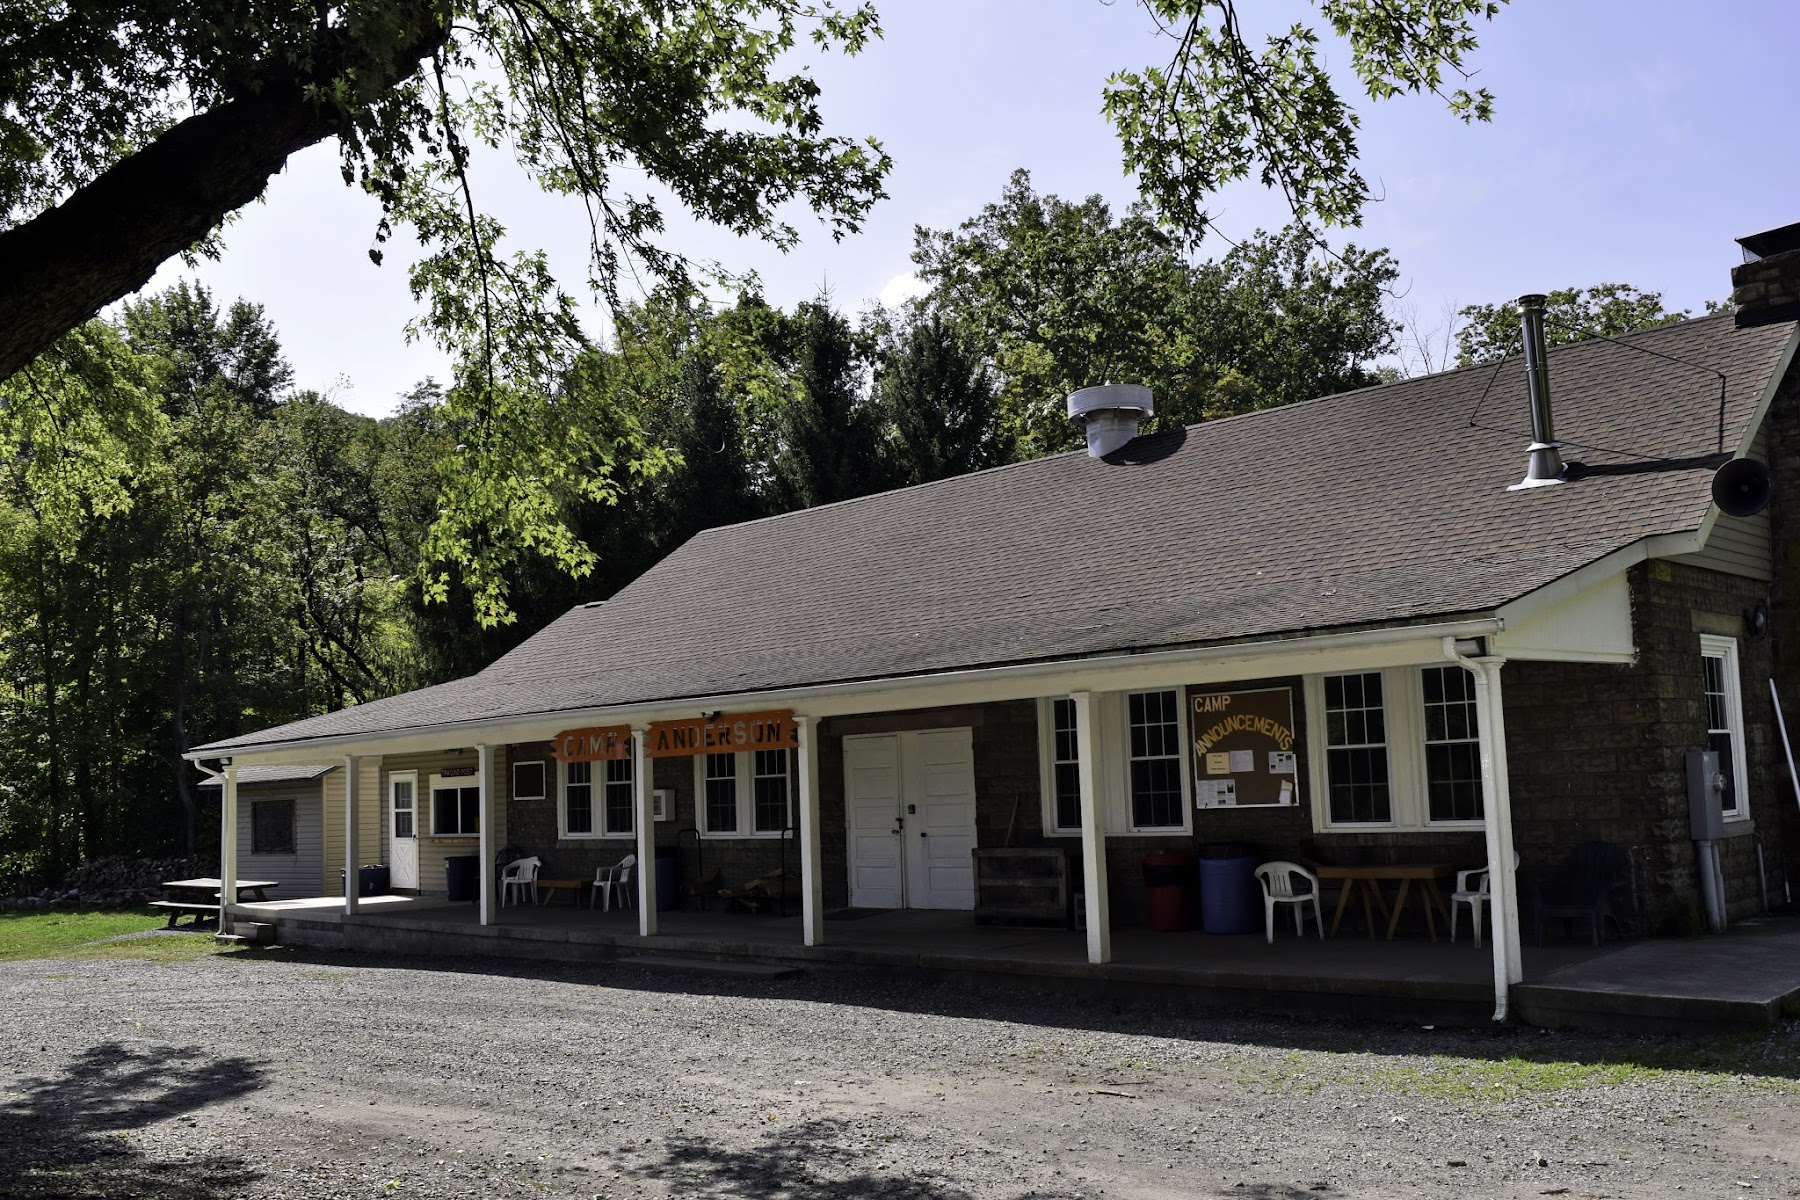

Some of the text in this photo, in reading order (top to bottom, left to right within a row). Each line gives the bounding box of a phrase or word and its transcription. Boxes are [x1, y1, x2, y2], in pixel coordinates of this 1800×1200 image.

[1195, 696, 1231, 712] CAMP
[563, 718, 781, 756] CAMP ANDERSON
[1195, 715, 1293, 757] ANNOUNCEMENTS
